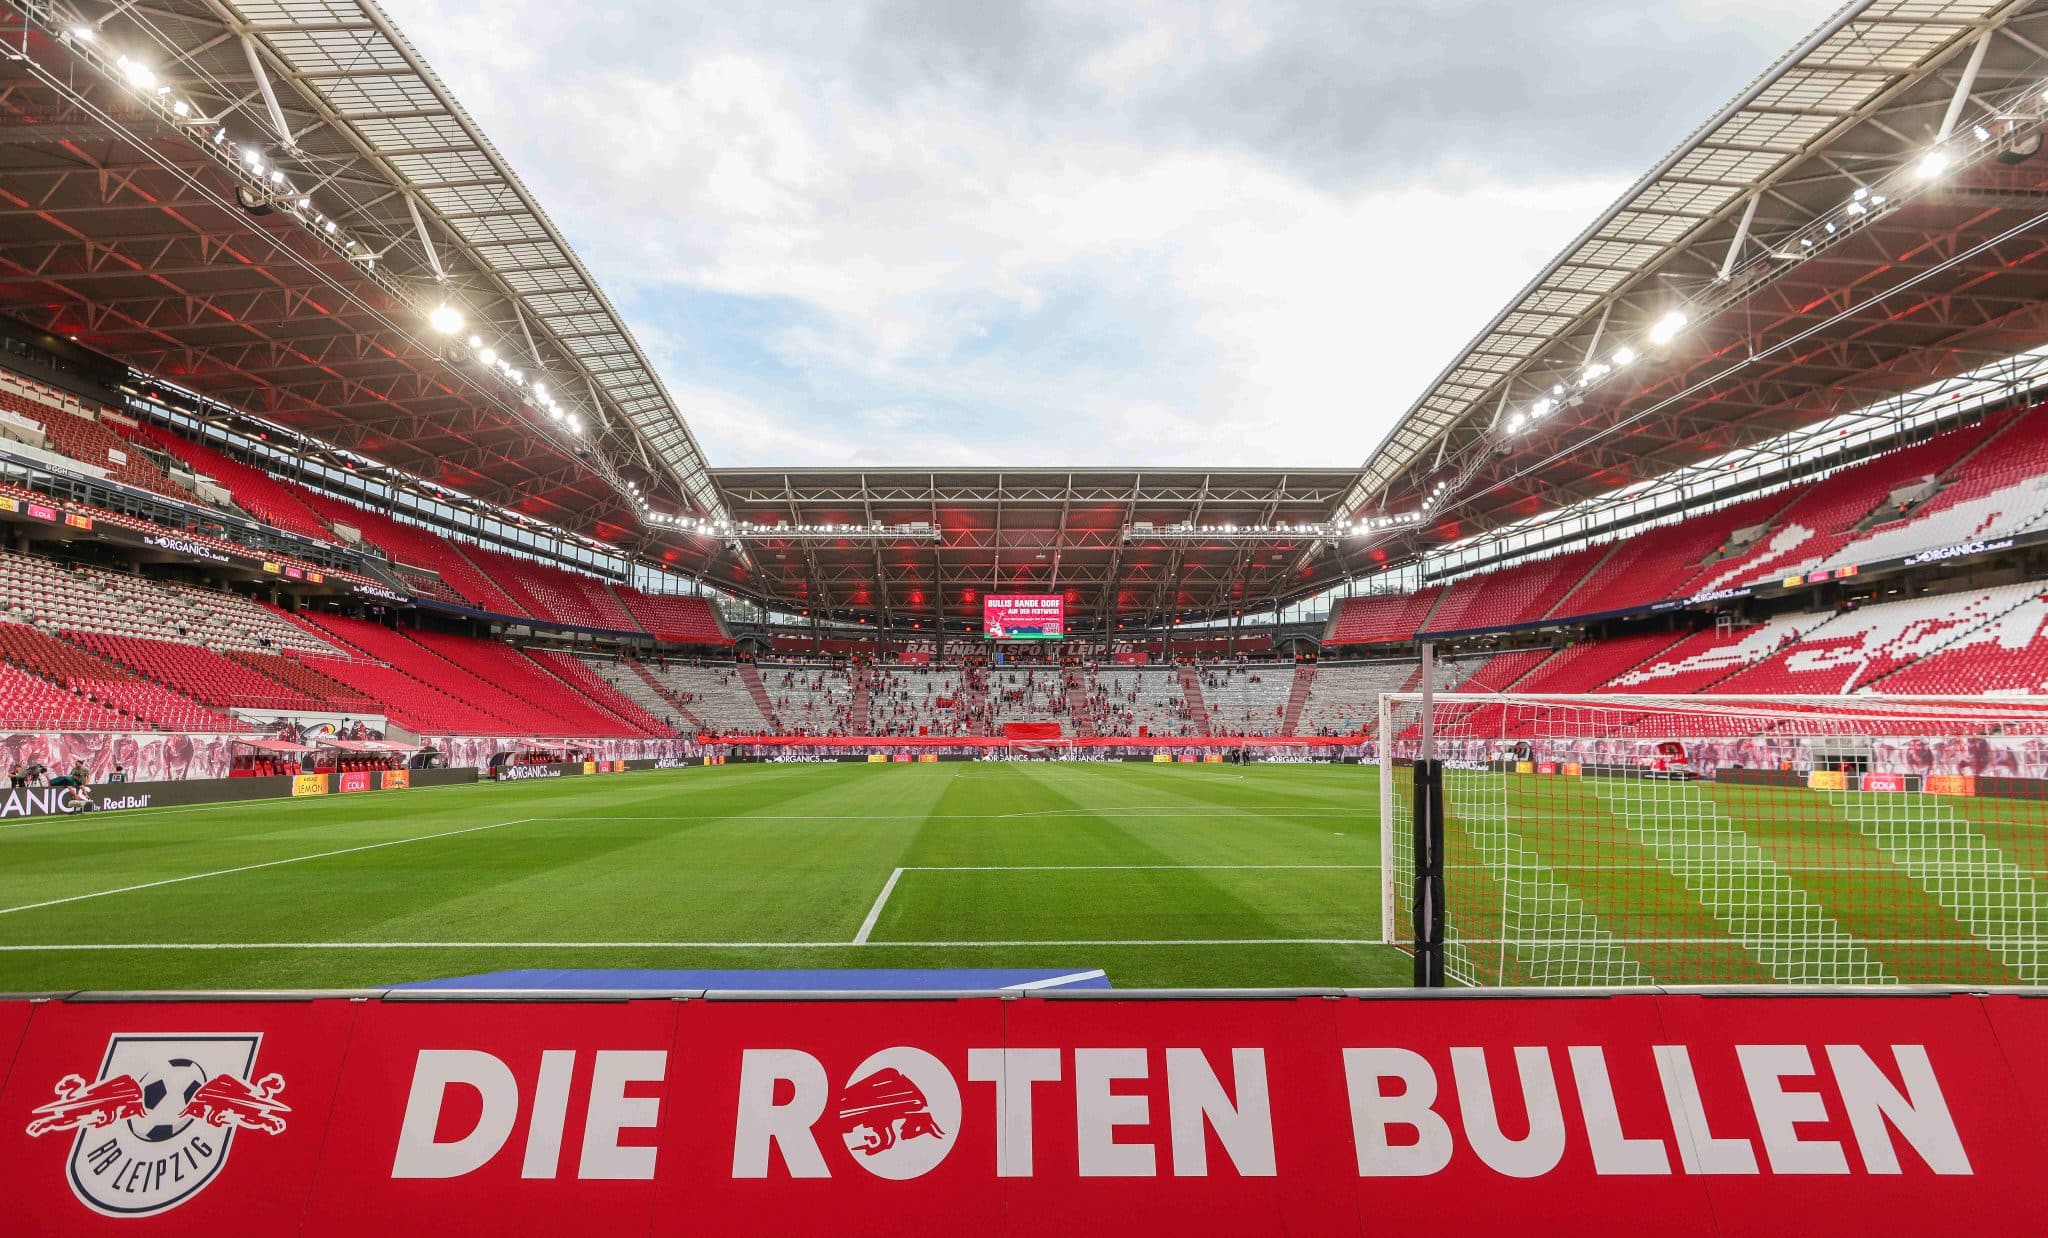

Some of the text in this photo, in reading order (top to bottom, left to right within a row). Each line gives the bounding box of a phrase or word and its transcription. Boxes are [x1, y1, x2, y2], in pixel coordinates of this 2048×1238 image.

[160, 537, 210, 558] ORGANICS
[1923, 542, 1984, 561] ORGANICS
[1014, 599, 1038, 608] BANDE
[1041, 599, 1060, 608] DORF
[778, 755, 820, 763] ORGANICS
[512, 765, 548, 780] ORGANICS
[299, 784, 323, 794] LEMON
[347, 780, 365, 790] COLA
[1870, 781, 1896, 790] COLA
[103, 796, 126, 810] Red
[127, 794, 149, 808] Bull
[390, 1044, 1975, 1180] DIE ROTEN BULLEN
[87, 1136, 213, 1193] RB LEIPZIG
